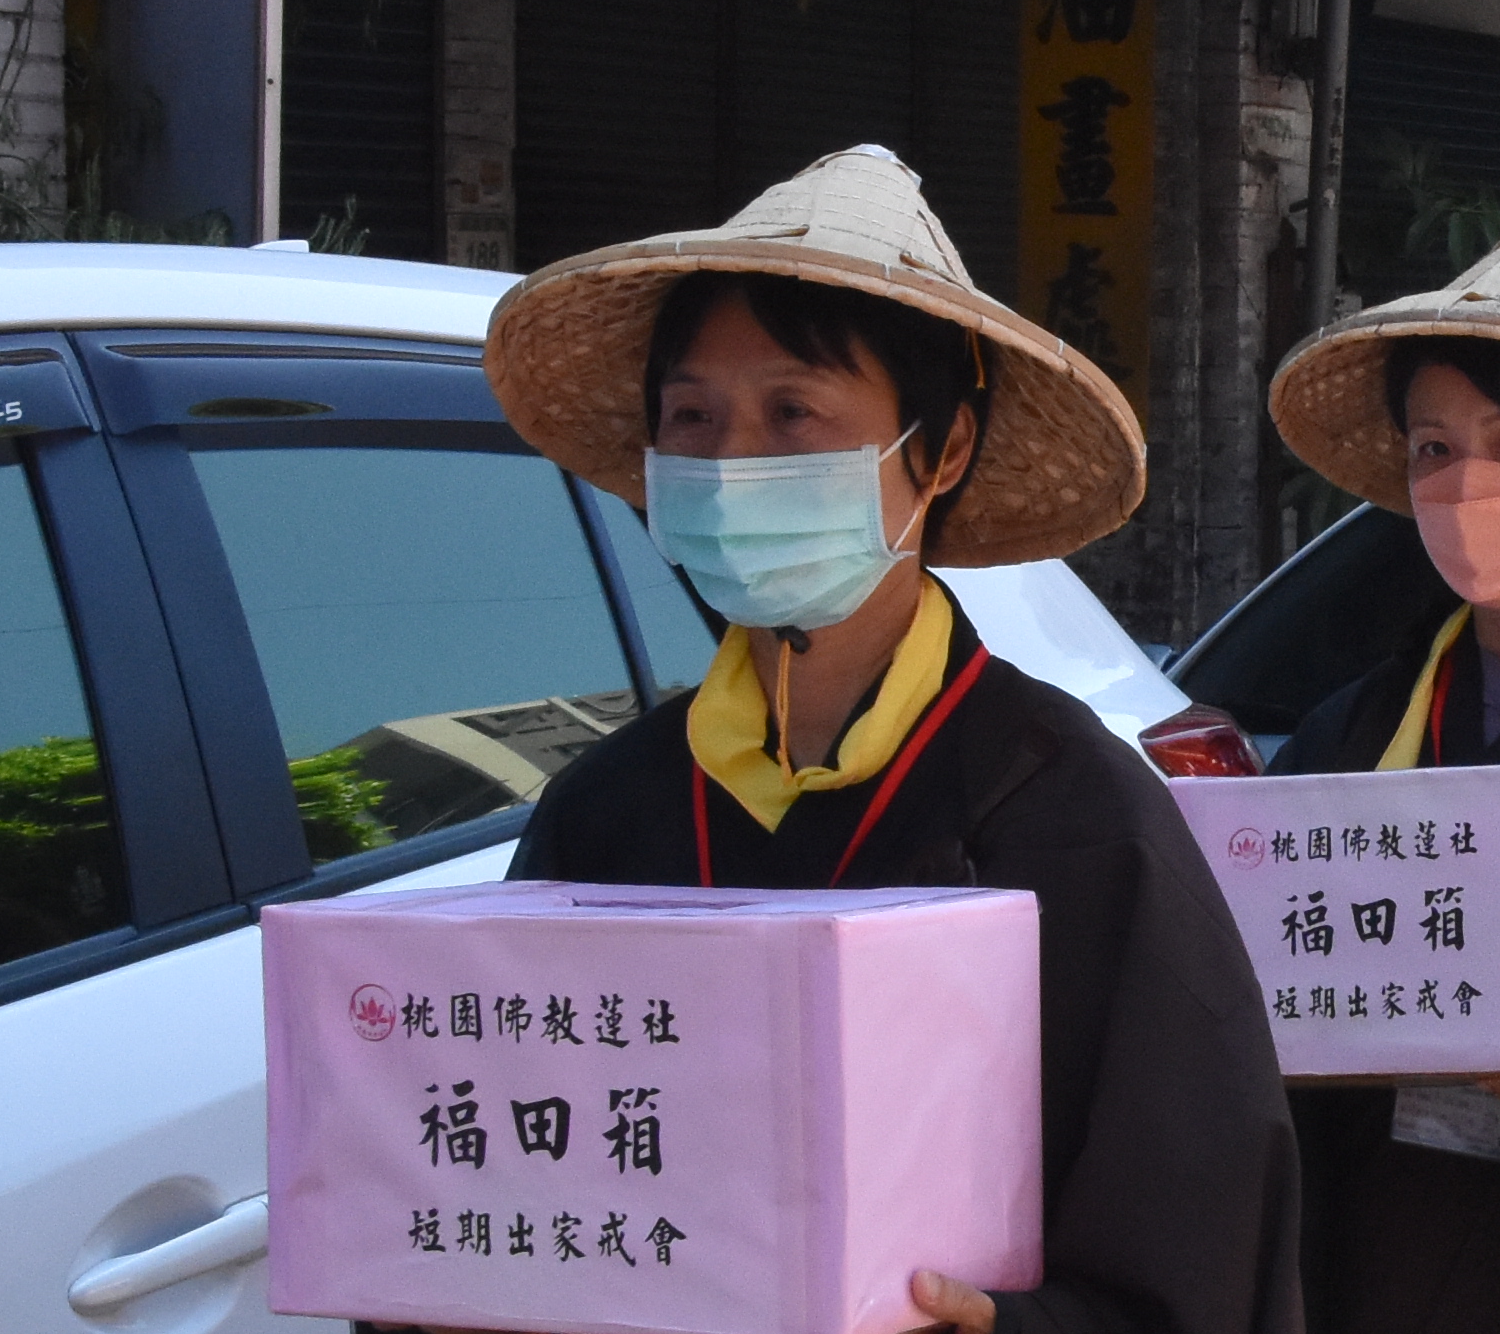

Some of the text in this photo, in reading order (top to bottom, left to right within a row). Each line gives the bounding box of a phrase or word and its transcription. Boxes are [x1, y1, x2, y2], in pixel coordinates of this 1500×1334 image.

[1270, 819, 1479, 865] 桃園佛教蓮社
[1280, 886, 1466, 957] 福田箱
[400, 992, 681, 1049] 桃園佛教蓮社
[1272, 978, 1484, 1021] 短期出家戒會
[418, 1079, 663, 1177] 福田箱
[407, 1207, 688, 1268] 短期出家戒會
